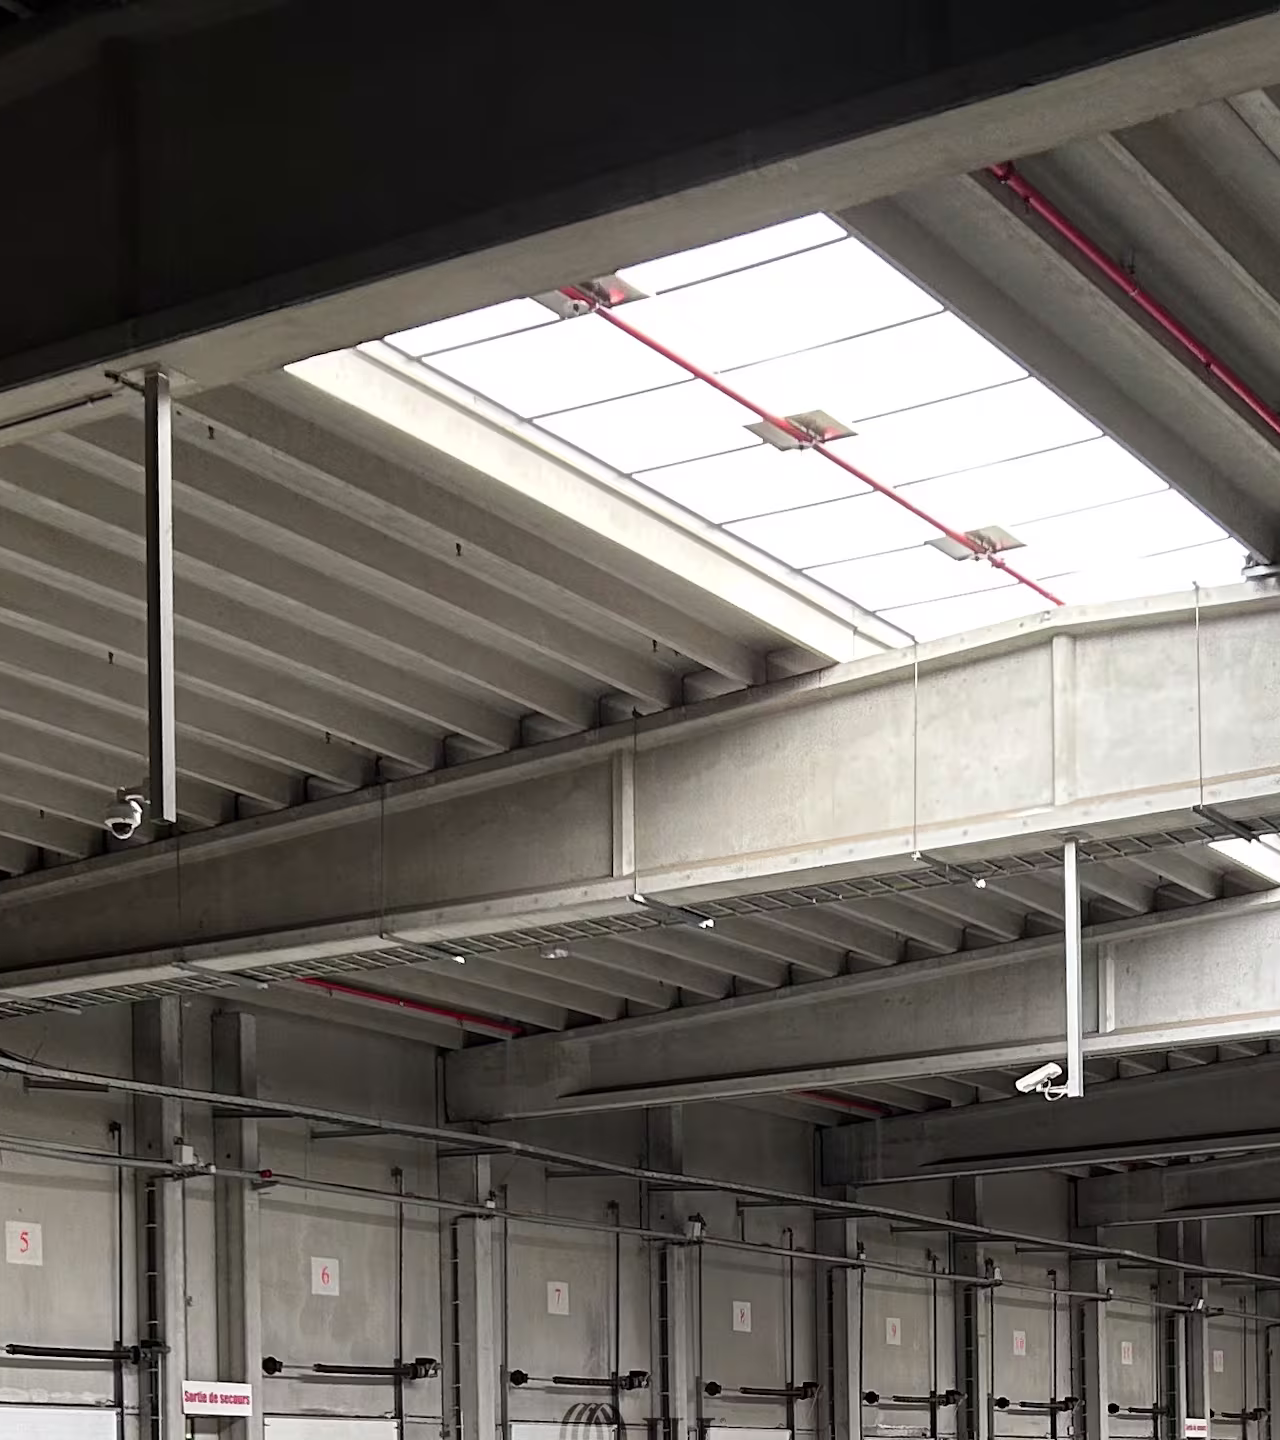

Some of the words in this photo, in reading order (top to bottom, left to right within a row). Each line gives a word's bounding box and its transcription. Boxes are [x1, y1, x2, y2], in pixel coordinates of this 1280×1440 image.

[19, 1230, 29, 1253] 5
[321, 1265, 330, 1285] 6
[554, 1288, 562, 1305] 7
[890, 1322, 897, 1337] 9
[184, 1390, 207, 1403] Sortie
[209, 1392, 218, 1404] de
[220, 1394, 250, 1405] secours
